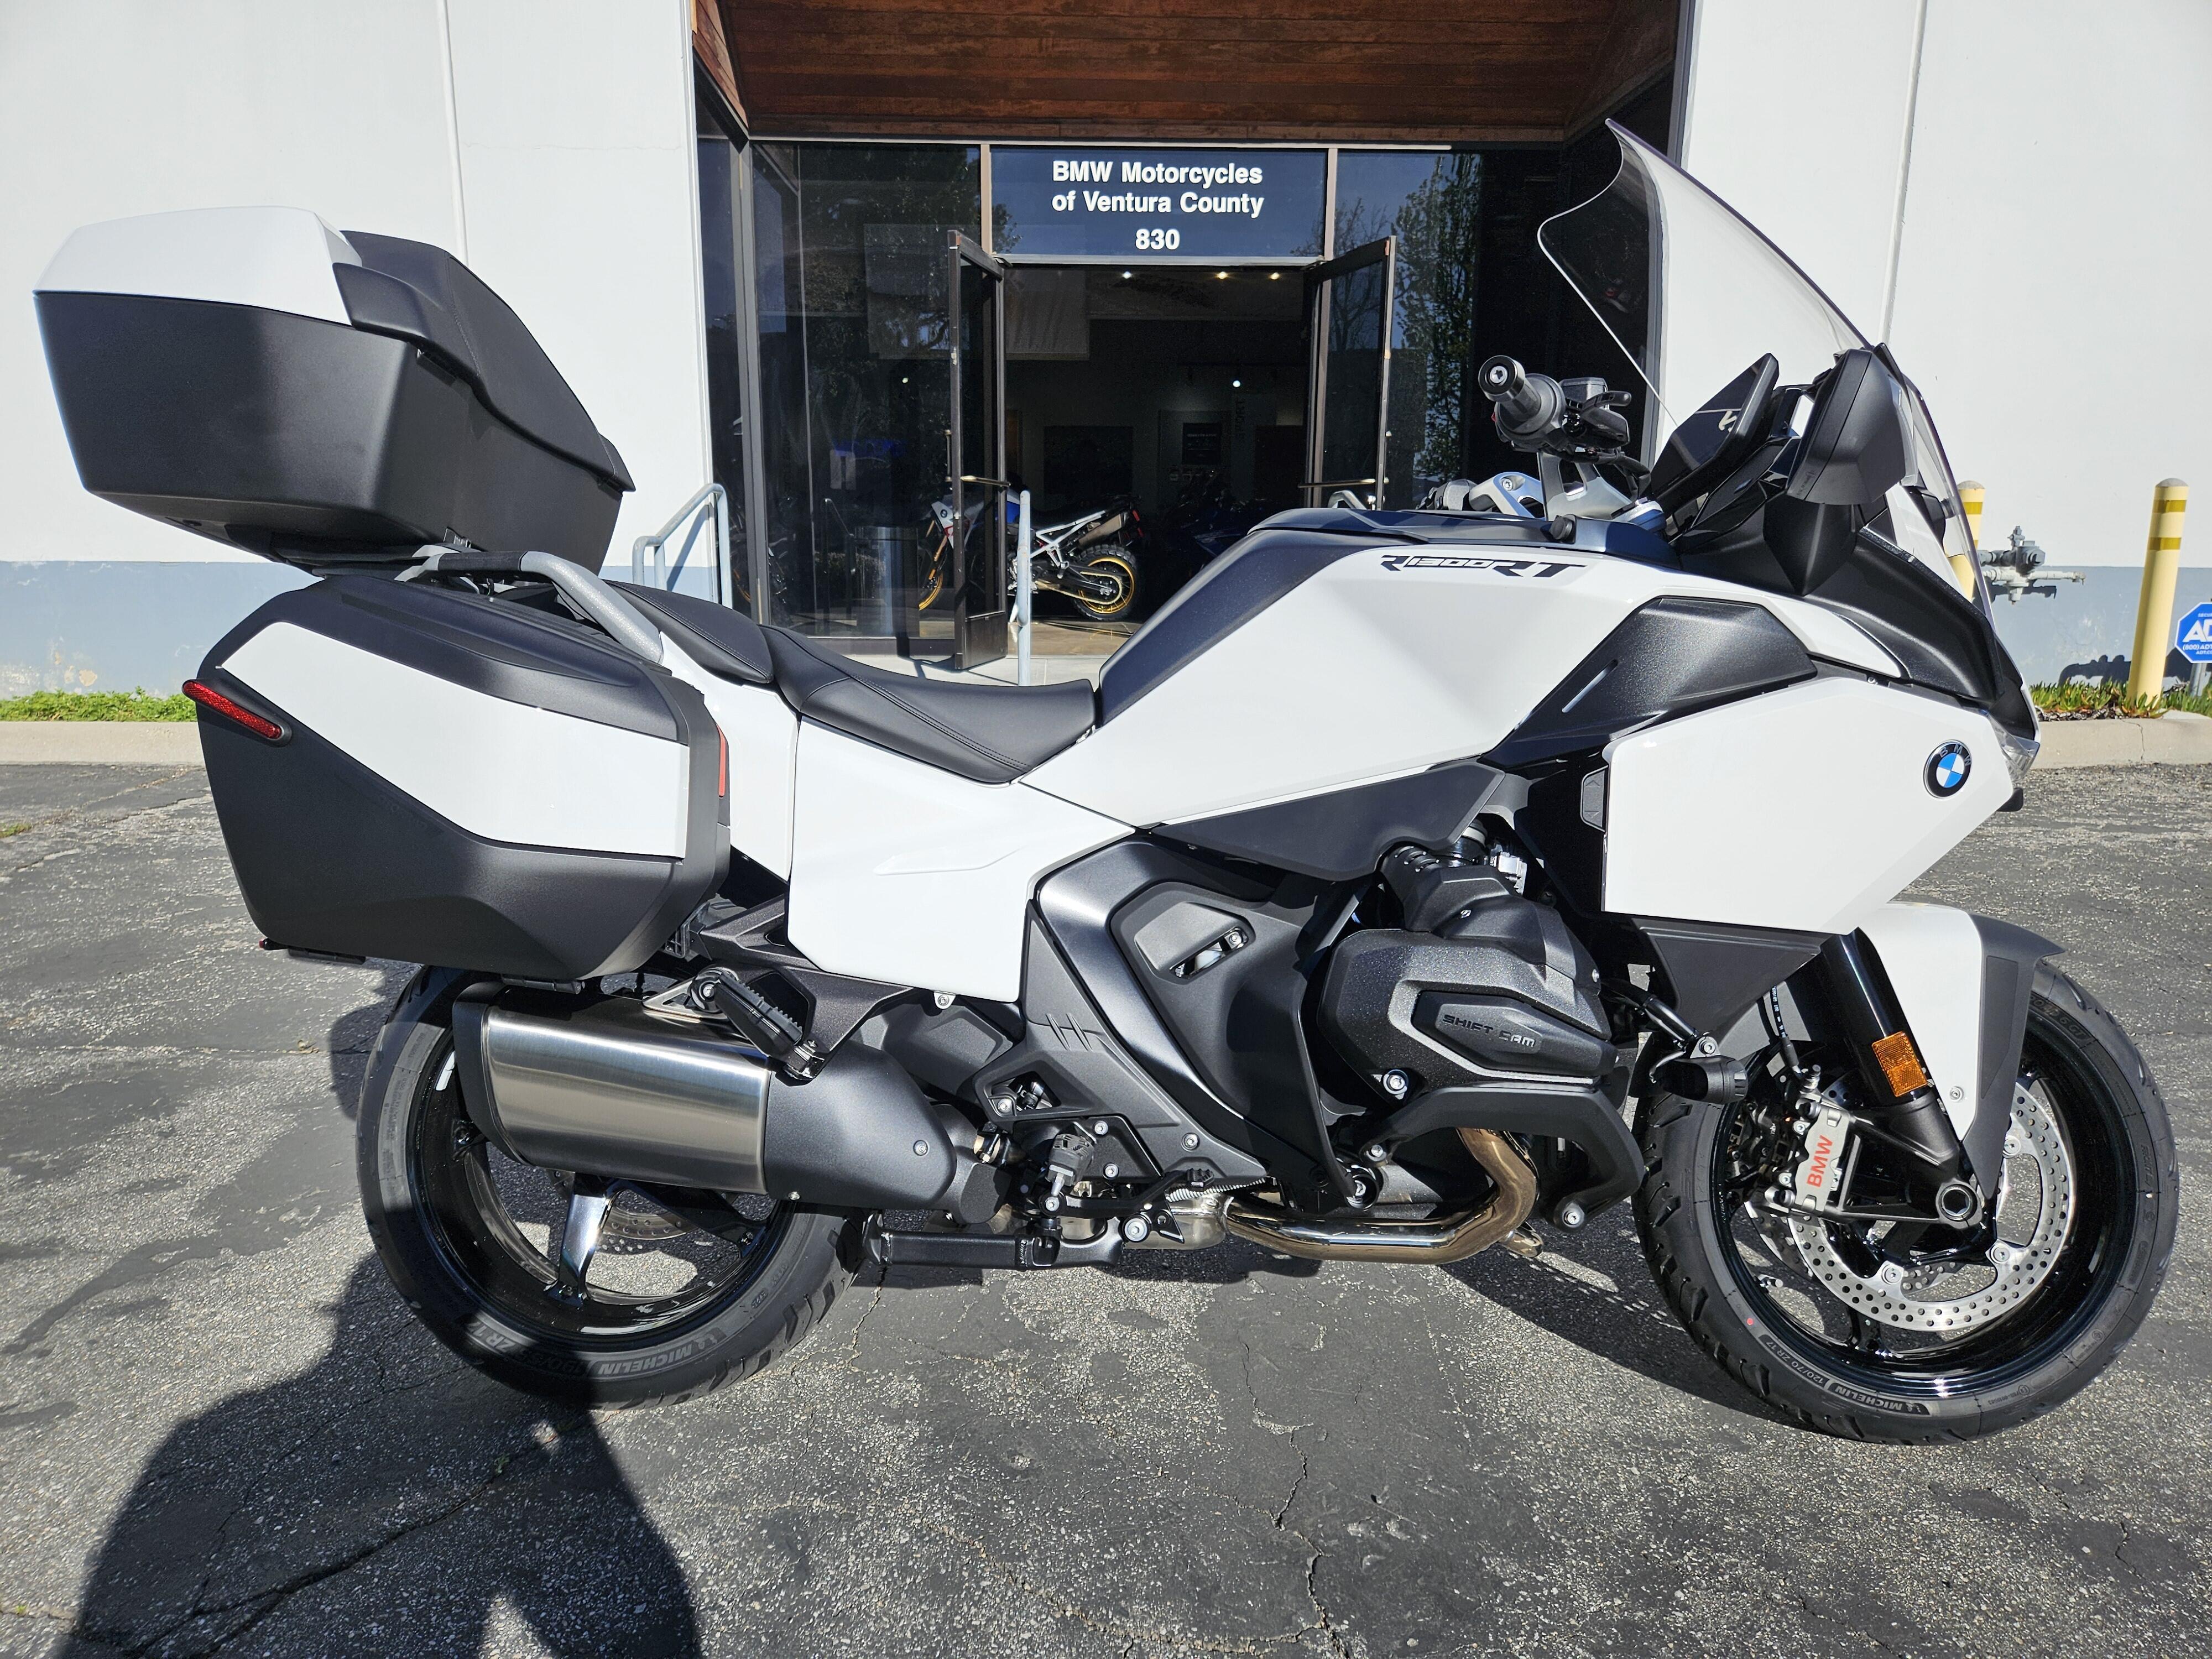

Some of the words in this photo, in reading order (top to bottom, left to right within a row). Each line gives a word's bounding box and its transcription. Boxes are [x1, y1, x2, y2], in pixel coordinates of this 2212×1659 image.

[1052, 160, 1113, 182] BMW
[1121, 162, 1263, 189] Motorcycles
[1052, 190, 1076, 211] of
[1083, 191, 1171, 213] Ventura
[1180, 192, 1265, 218] County
[1135, 228, 1180, 250] 830
[1938, 744, 1972, 766] BMW
[1442, 1014, 1494, 1035] SHIFT
[1498, 1030, 1536, 1048] CAM
[2069, 1025, 2086, 1036] GT
[1806, 1135, 1834, 1187] BMW
[486, 1335, 516, 1353] ZR
[1766, 1342, 1777, 1350] 17
[1777, 1349, 1791, 1361] ZR
[599, 1347, 693, 1375] MICHELIN
[1791, 1361, 1824, 1384] 120/70
[1835, 1386, 1903, 1411] MICHELIN
